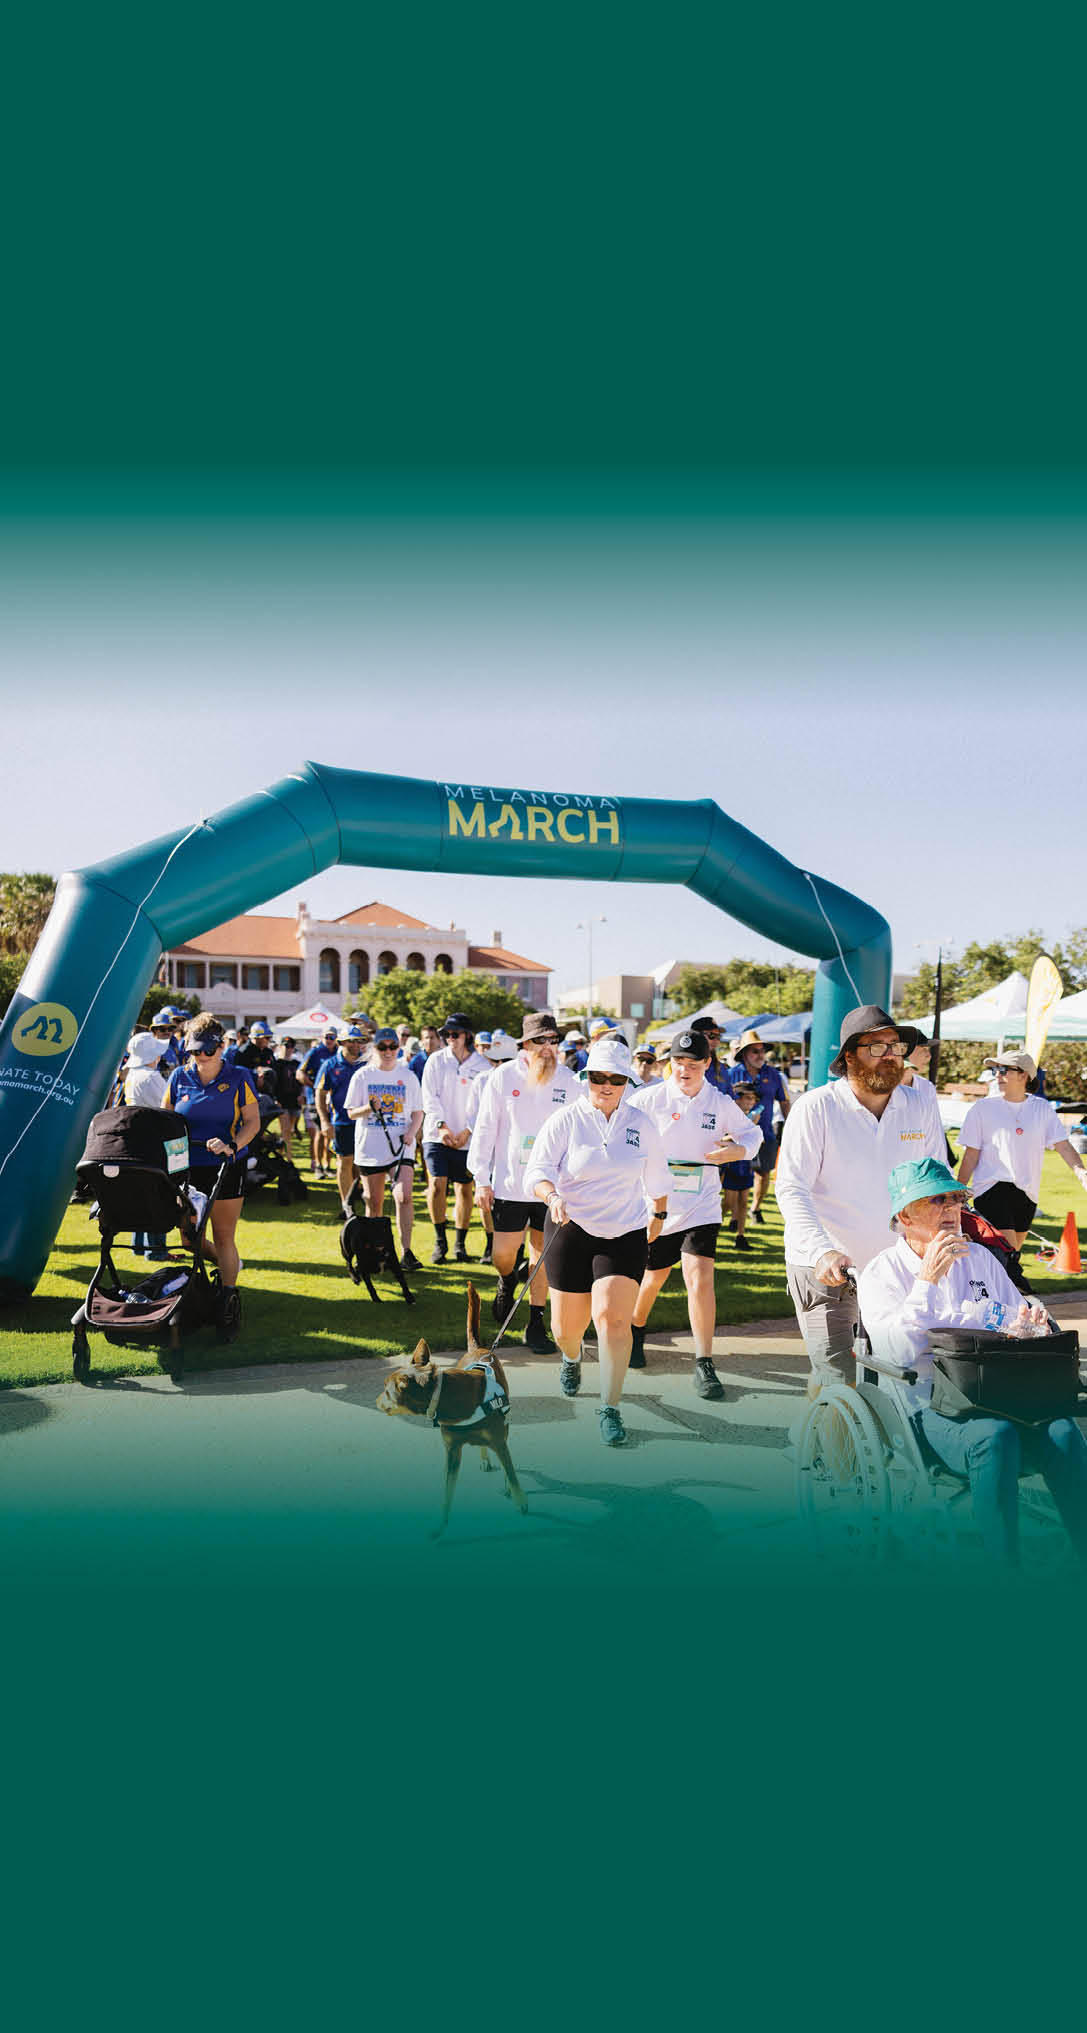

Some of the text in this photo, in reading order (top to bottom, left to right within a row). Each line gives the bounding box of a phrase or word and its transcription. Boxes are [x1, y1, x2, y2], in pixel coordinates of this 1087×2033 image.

[444, 785, 616, 809] MELANOMA
[448, 799, 619, 844] MARCH
[0, 1080, 74, 1105] mamarch.org.au
[34, 1070, 80, 1096] TODAY
[981, 1287, 989, 1299] 4
